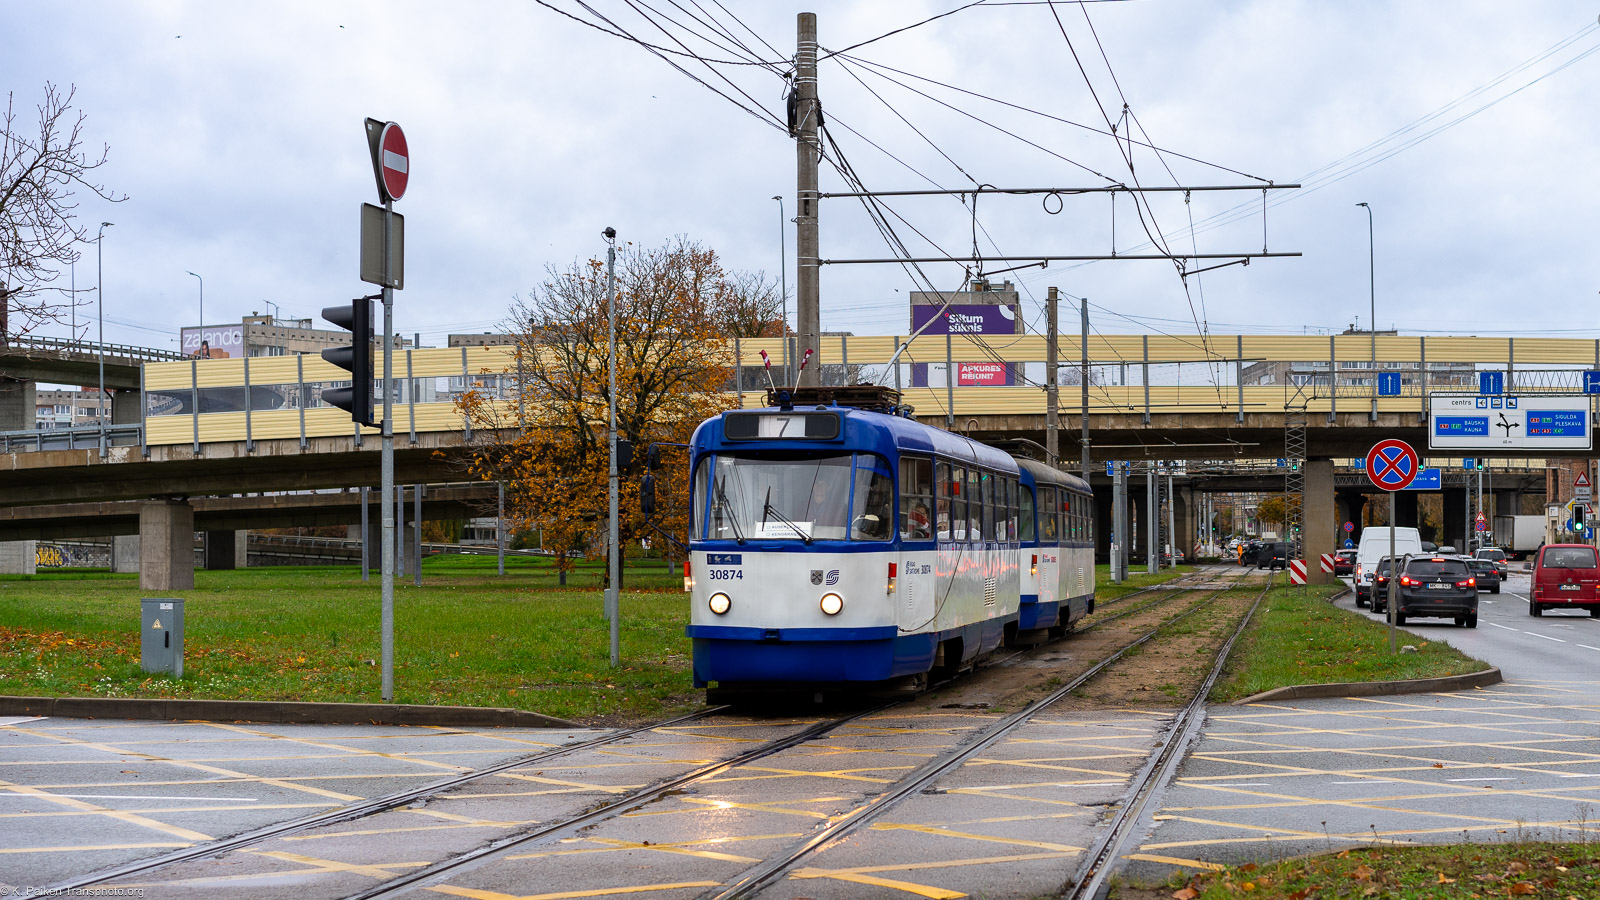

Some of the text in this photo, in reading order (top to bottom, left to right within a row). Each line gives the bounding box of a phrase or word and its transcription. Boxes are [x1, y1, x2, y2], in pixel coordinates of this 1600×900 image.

[184, 329, 242, 348] zalando
[776, 417, 791, 437] 7
[709, 569, 744, 580] 30874
